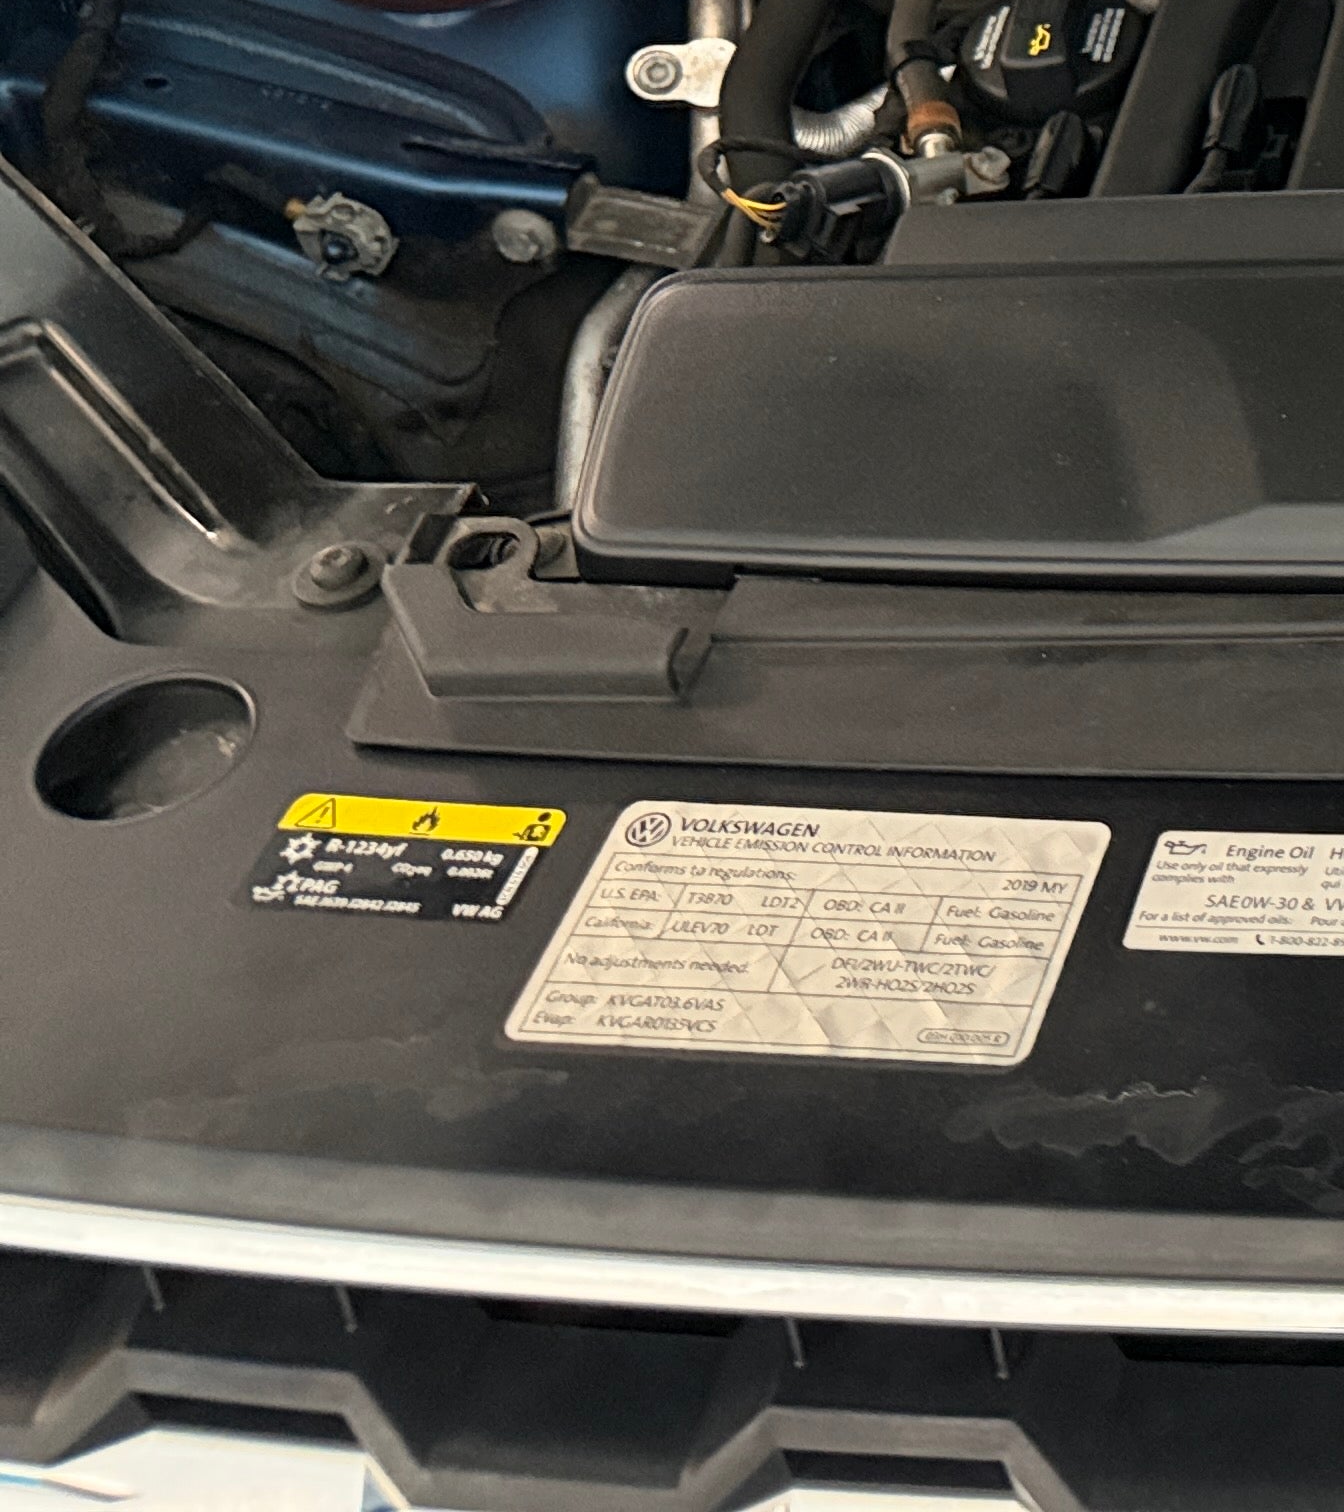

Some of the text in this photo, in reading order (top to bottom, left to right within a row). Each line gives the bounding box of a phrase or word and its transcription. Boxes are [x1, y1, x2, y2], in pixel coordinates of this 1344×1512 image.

[681, 817, 820, 838] VOLKSWAGEN
[671, 835, 997, 862] VEHICLE EMISSION CONTROL INFORMATION
[1226, 844, 1286, 860] Engine
[1289, 846, 1315, 859] Oil
[615, 860, 687, 876] Conforms
[1209, 862, 1225, 871] oil
[1226, 862, 1251, 872] that
[1002, 878, 1068, 894] 2019 MY
[868, 900, 891, 914] CA
[1302, 896, 1315, 911] &
[988, 906, 1055, 922] Gasoline
[1139, 910, 1158, 921] For
[1171, 912, 1190, 922] list
[1192, 912, 1207, 922] of
[746, 921, 779, 936] LDT
[857, 928, 879, 942] CA
[976, 935, 1045, 951] Gasoline
